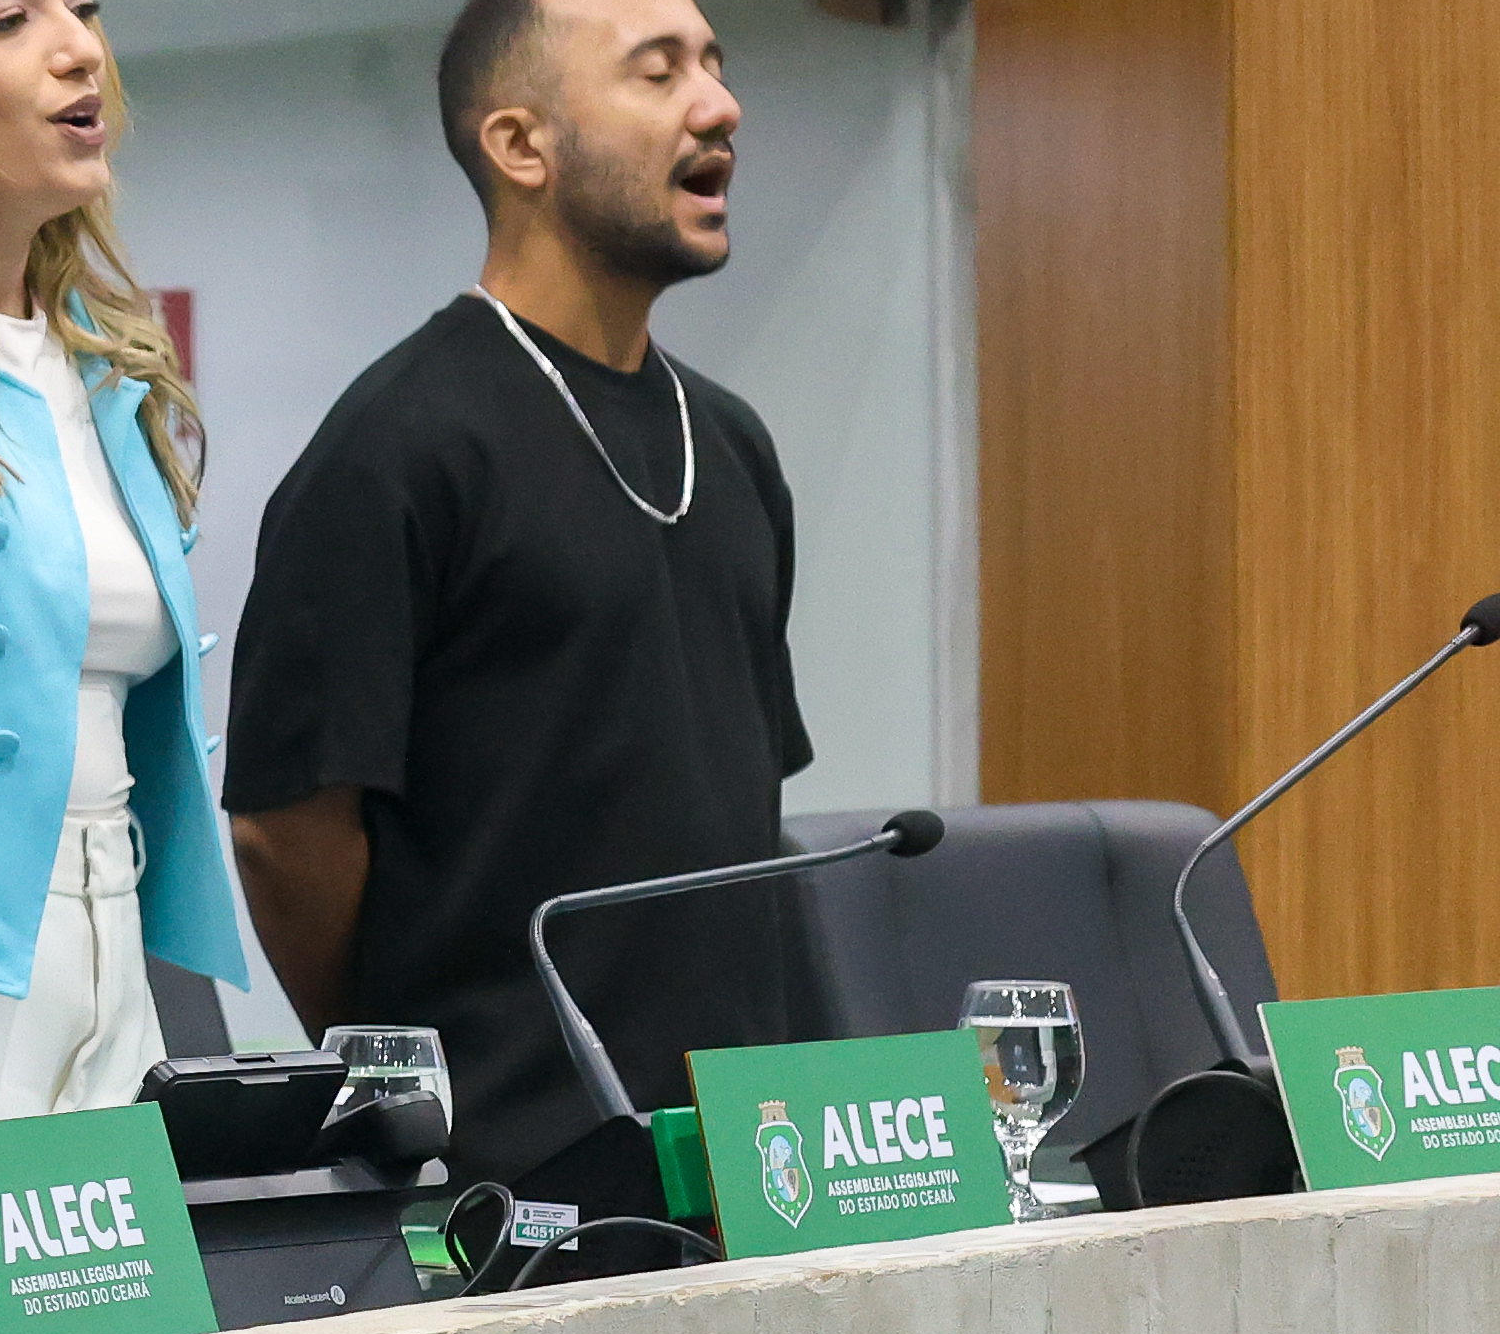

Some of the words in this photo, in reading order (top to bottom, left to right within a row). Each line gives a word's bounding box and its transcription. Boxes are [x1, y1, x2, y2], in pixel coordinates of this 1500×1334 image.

[824, 1095, 953, 1169] ALECE
[1411, 1114, 1477, 1133] ASSEMBLEIA
[1422, 1134, 1440, 1149] DO
[1441, 1130, 1484, 1147] ESTADO
[828, 1176, 893, 1197] ASSEMBLEIA
[893, 1169, 960, 1190] LEGISLATIVA
[838, 1199, 855, 1215] DO
[857, 1194, 900, 1213] ESTADO
[901, 1192, 918, 1208] DO
[919, 1185, 956, 1206] CEARÁ
[1, 1177, 145, 1264] ALECE
[11, 1269, 82, 1296] ASSEMBLEIA
[80, 1259, 154, 1285] LEGISLATIVA
[23, 1297, 42, 1316] DO
[44, 1290, 90, 1313] ESTADO
[91, 1287, 109, 1304] DO
[111, 1277, 151, 1302] CEARÁ
